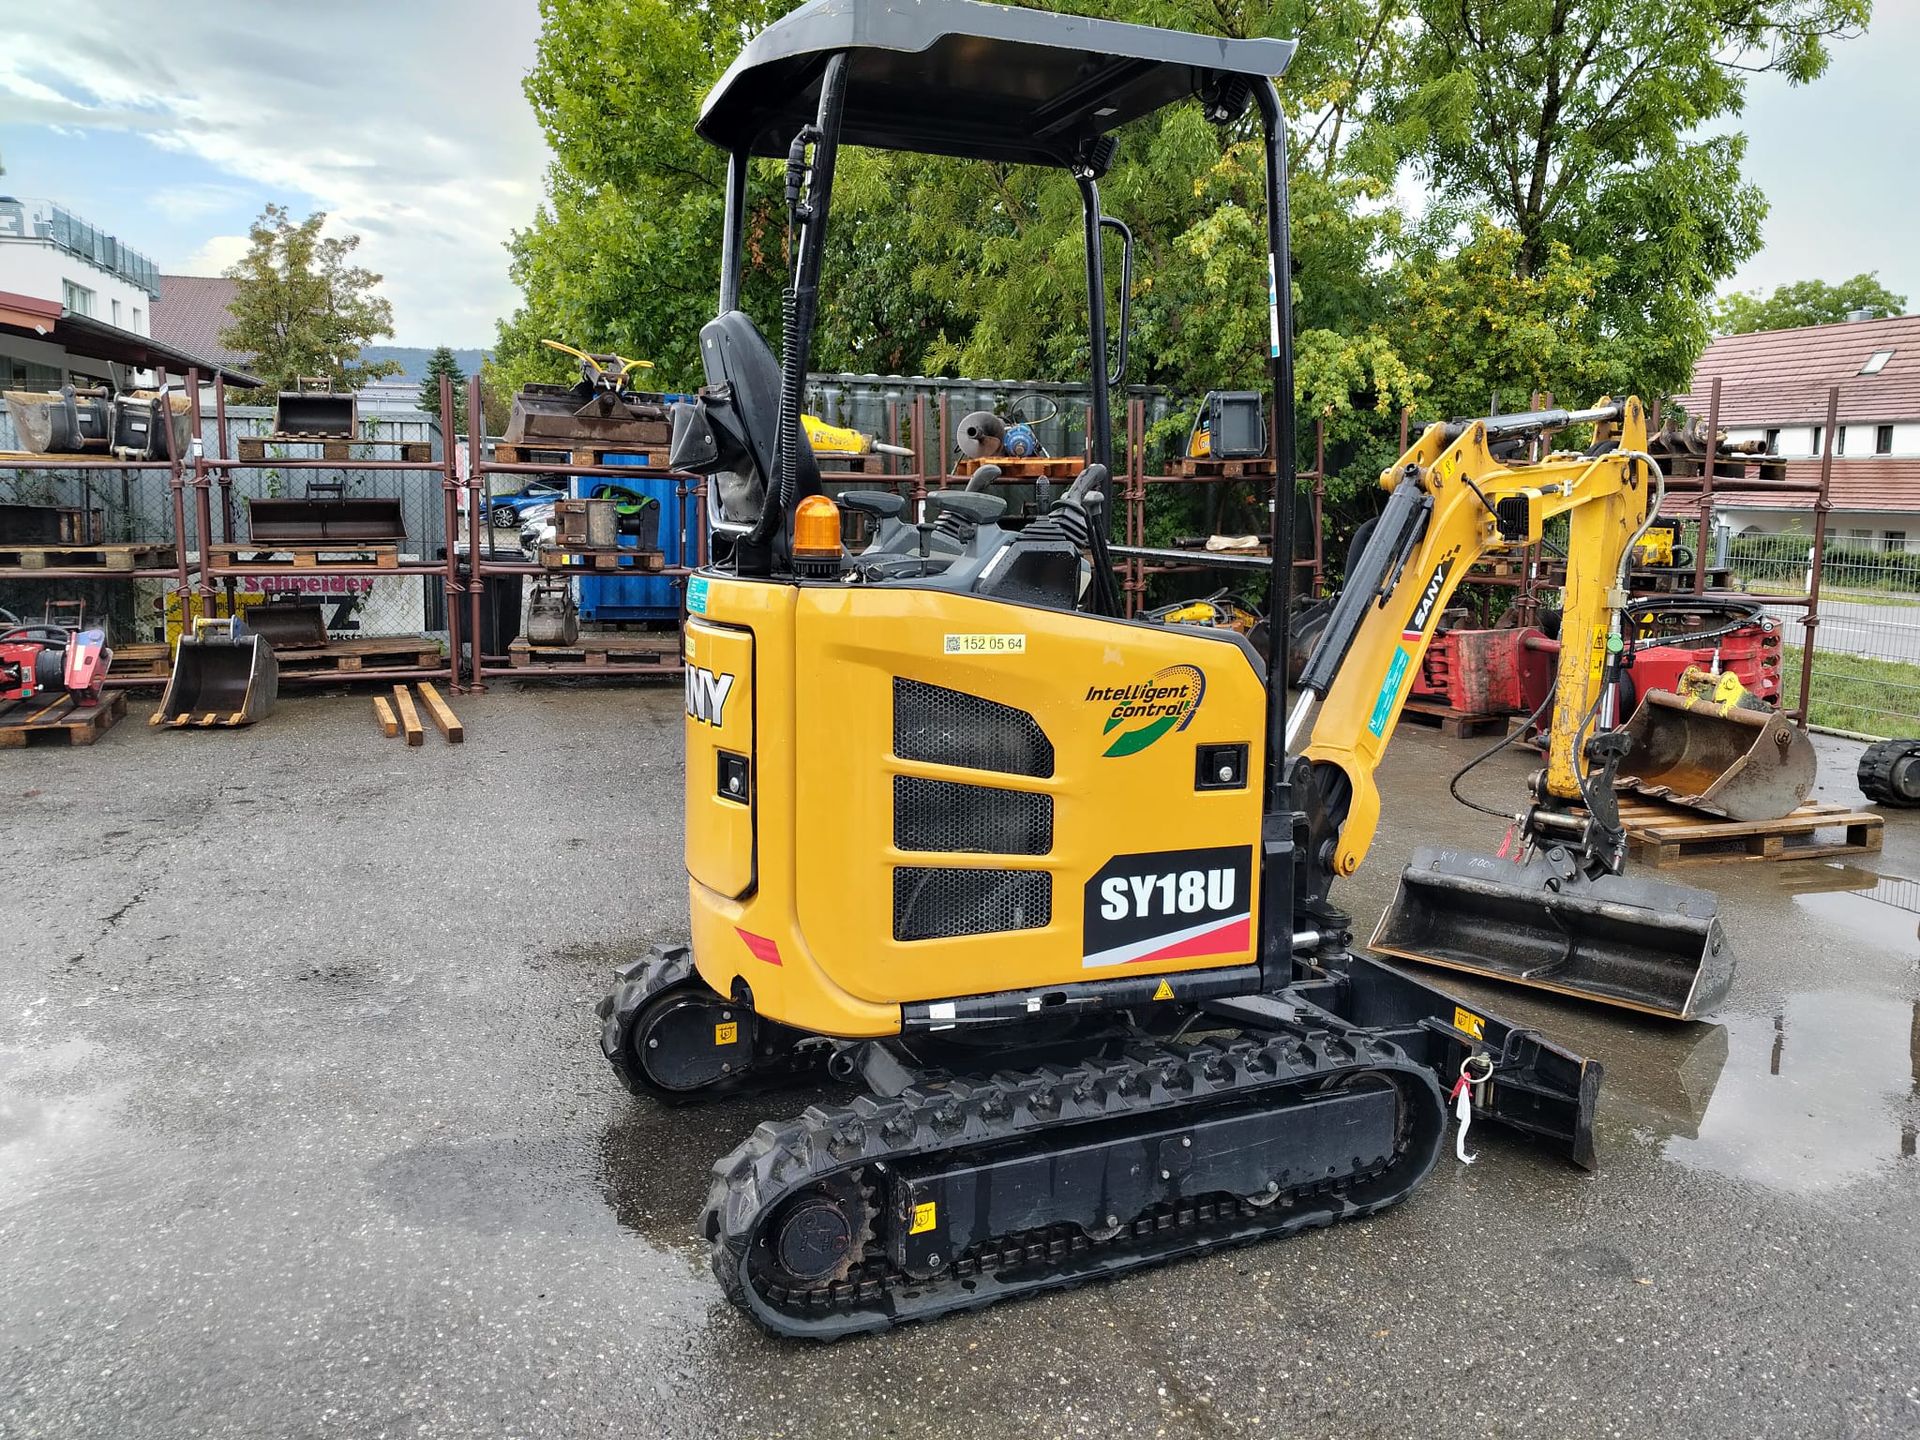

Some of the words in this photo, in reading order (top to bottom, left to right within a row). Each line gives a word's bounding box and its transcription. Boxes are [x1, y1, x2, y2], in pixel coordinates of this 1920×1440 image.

[244, 575, 374, 594] Schneider
[1414, 564, 1444, 630] SANY
[963, 637, 986, 651] 152
[988, 637, 1005, 651] 05
[1007, 637, 1024, 651] 64
[1085, 682, 1190, 704] Intelligent
[1111, 700, 1185, 718] control
[1100, 868, 1236, 921] SY18U
